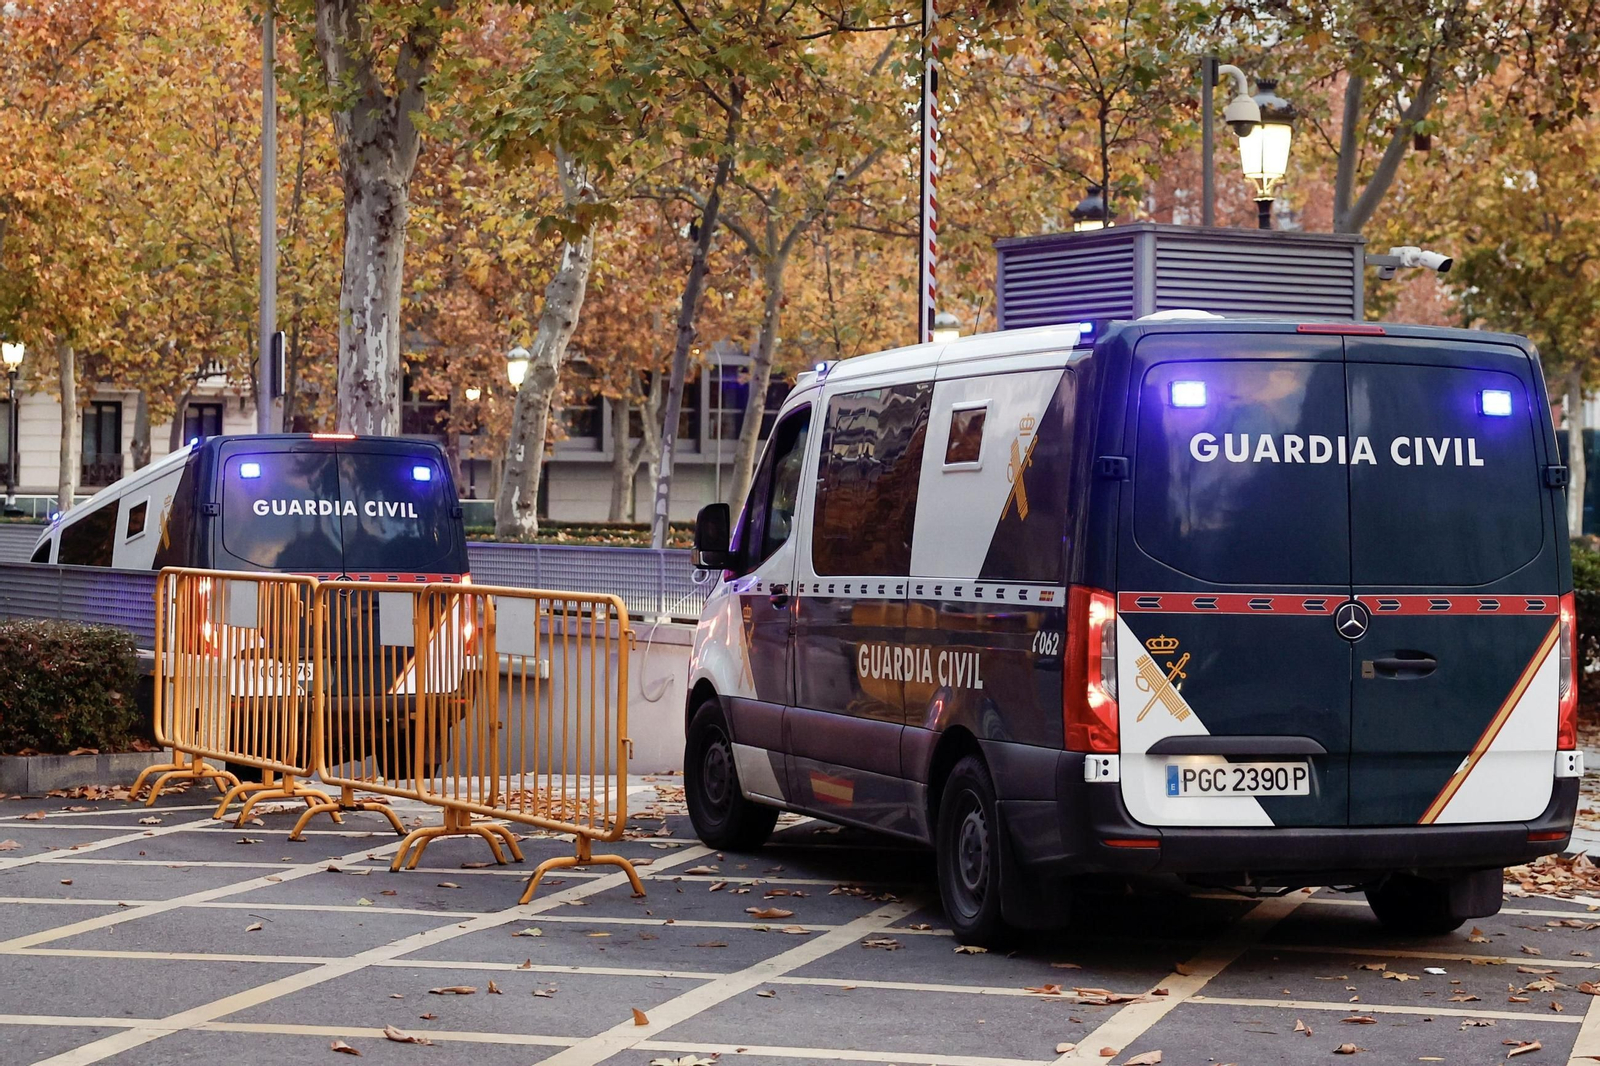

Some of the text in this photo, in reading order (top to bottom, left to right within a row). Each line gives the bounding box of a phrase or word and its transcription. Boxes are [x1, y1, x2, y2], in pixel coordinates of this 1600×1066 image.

[1189, 432, 1485, 467] GUARDIA CIVIL
[252, 499, 418, 519] GUARDIA CIVIL
[1039, 631, 1060, 656] 062
[858, 643, 983, 690] GUARDIA CIVIL
[1170, 767, 1306, 792] E PGC 2390 P
